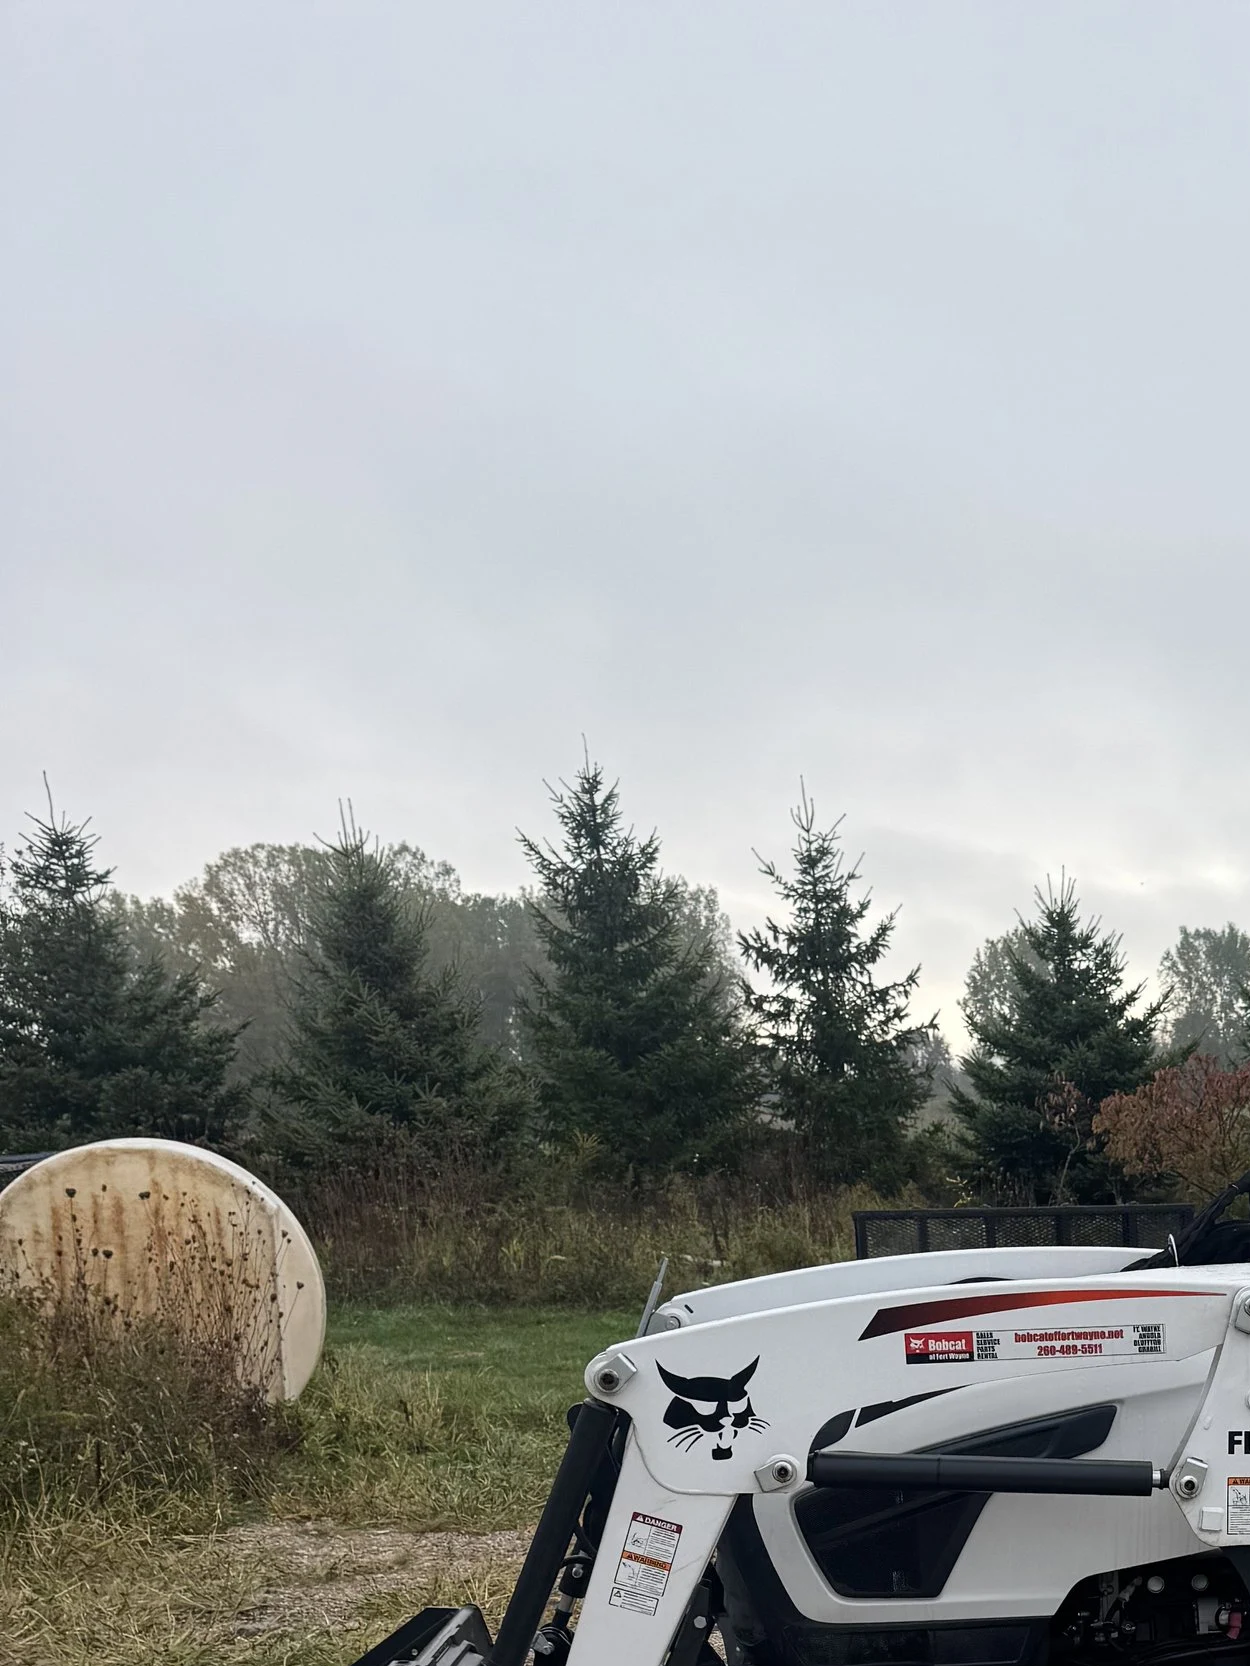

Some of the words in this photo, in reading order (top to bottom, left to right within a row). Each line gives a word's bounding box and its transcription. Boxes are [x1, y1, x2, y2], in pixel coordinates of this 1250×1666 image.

[1014, 1328, 1124, 1343] bobcatoffortwayne.net
[928, 1338, 966, 1351] Bobcat
[1037, 1343, 1103, 1356] 260-489-5511
[949, 1352, 970, 1360] Wayne
[644, 1517, 678, 1532] DANGER
[633, 1554, 667, 1569] WARNING
